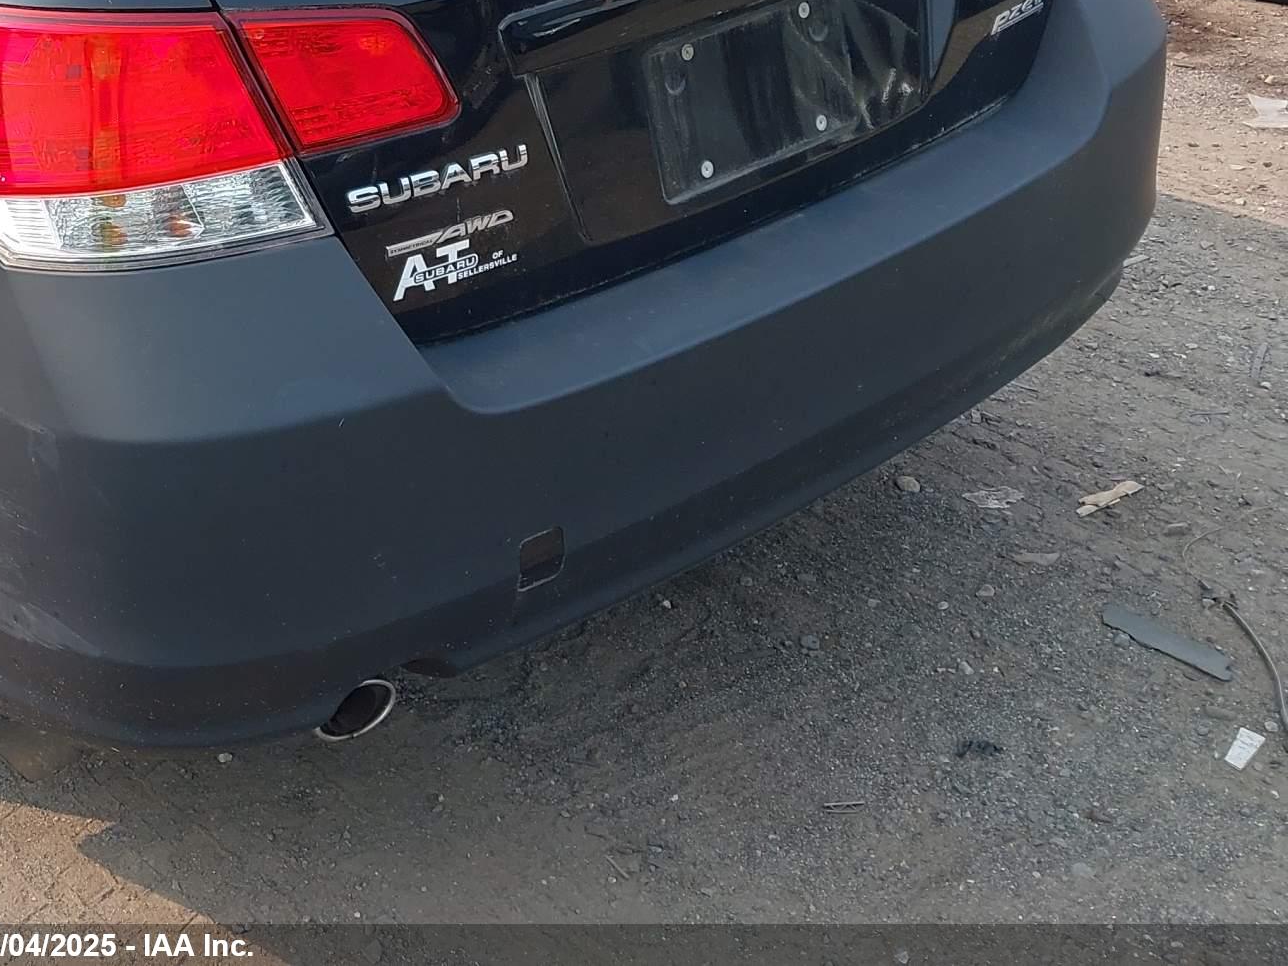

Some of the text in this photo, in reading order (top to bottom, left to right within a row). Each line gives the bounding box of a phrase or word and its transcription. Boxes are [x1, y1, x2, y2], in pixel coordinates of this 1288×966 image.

[346, 143, 529, 214] SUBARU
[434, 209, 514, 244] AWD
[457, 253, 518, 281] SELLERSVILLE
[491, 249, 505, 260] OF
[414, 256, 476, 284] SUBARU
